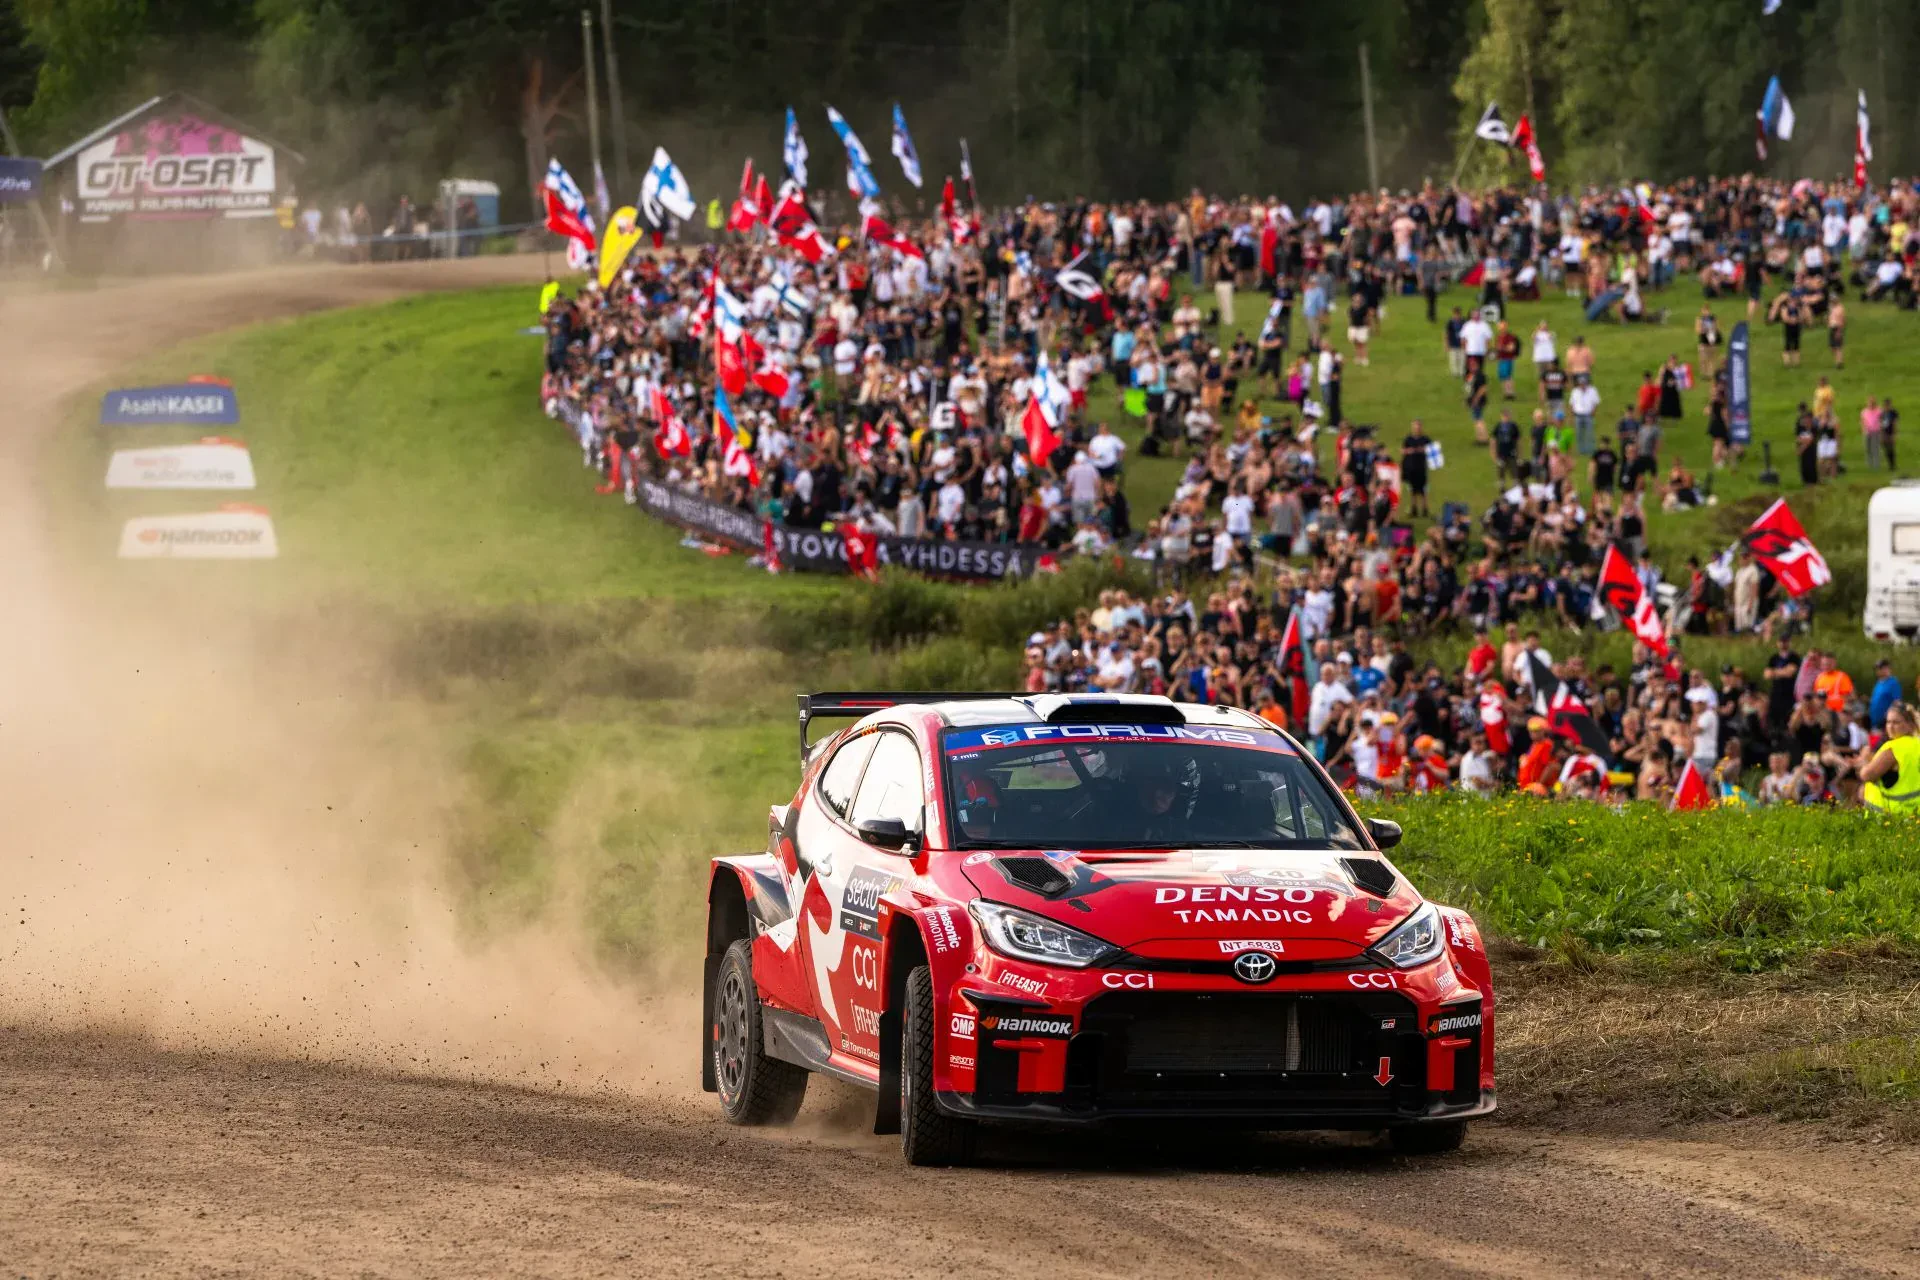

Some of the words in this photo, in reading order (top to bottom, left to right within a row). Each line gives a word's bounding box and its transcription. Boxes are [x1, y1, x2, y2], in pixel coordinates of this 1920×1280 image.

[86, 155, 264, 190] GT-OSAT
[1023, 724, 1257, 745] FORUM8
[847, 877, 879, 910] secto
[1155, 886, 1315, 904] DENSO
[1173, 908, 1313, 924] TAMADIC
[951, 1017, 975, 1036] OMP
